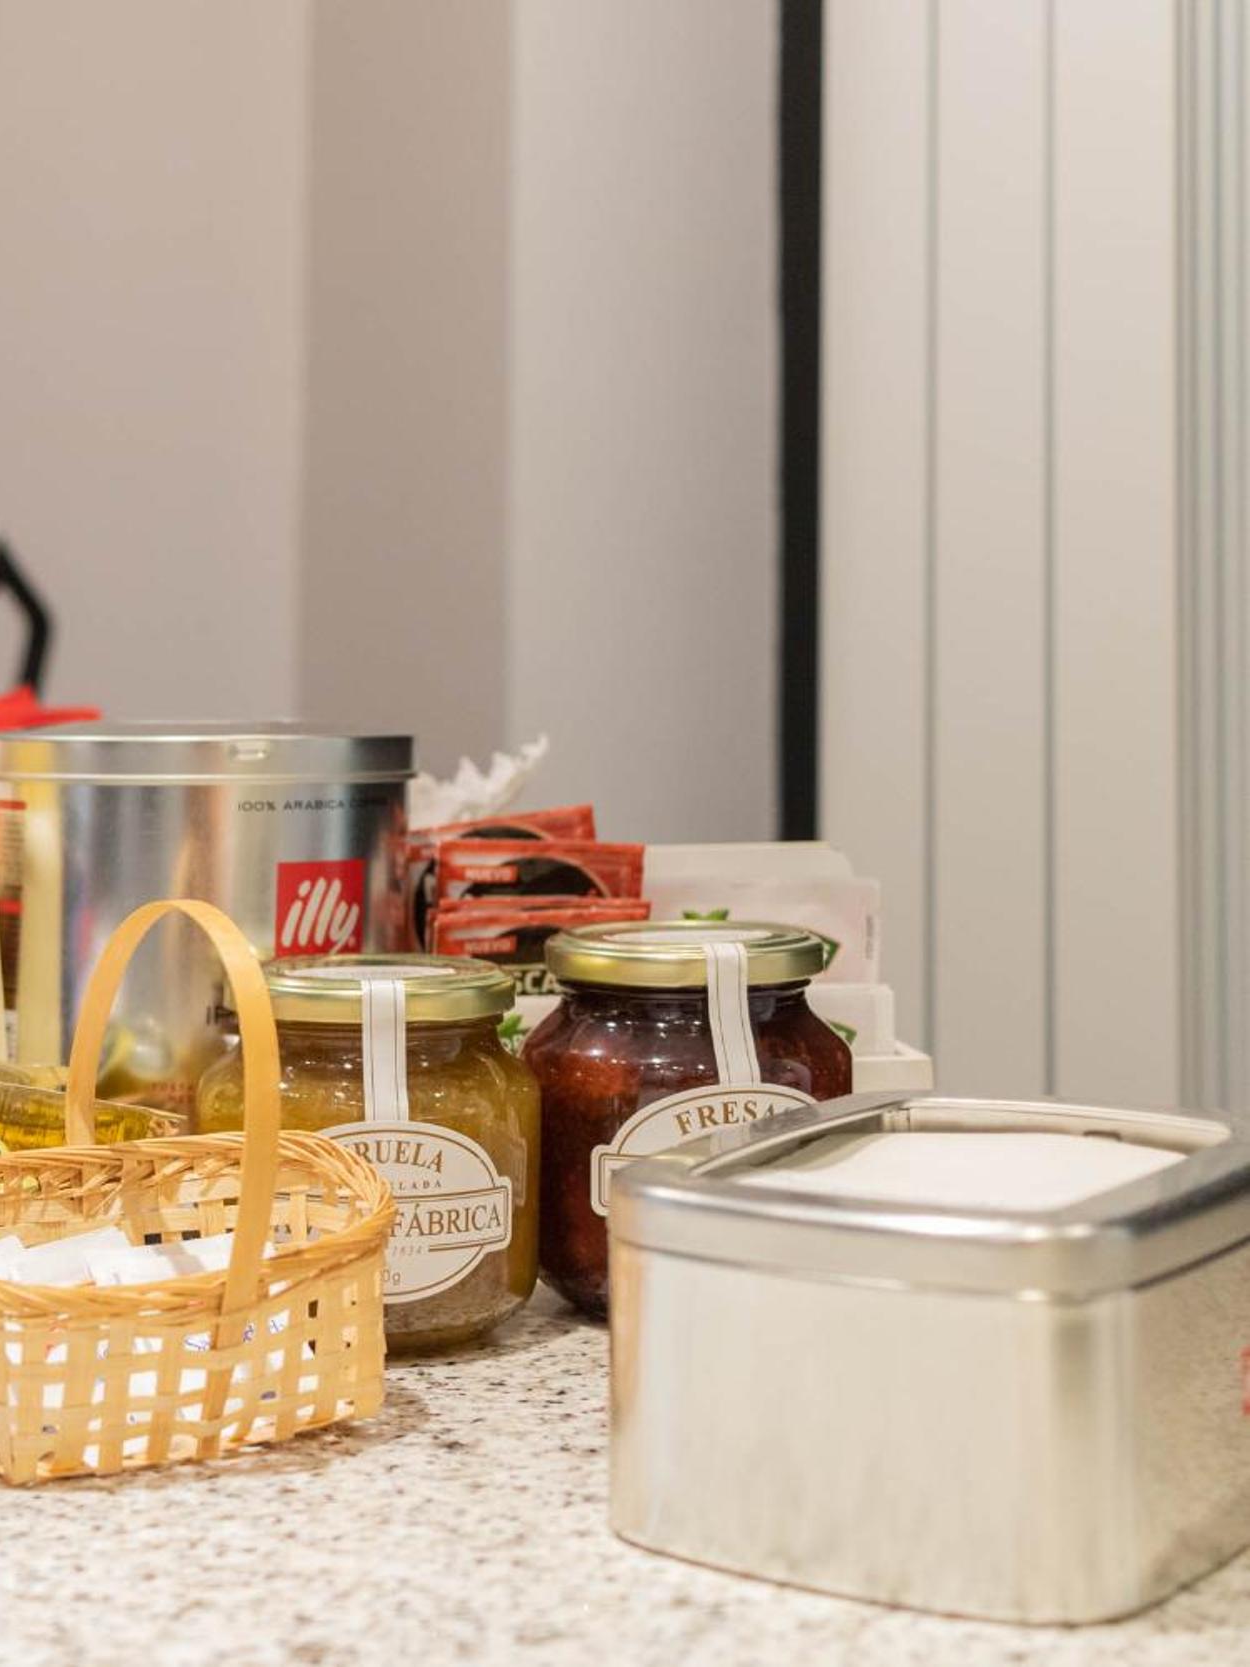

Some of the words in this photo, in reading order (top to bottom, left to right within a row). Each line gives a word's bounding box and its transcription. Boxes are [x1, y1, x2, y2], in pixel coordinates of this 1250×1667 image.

[236, 800, 277, 812] 100%
[282, 799, 346, 812] ARABICA
[280, 876, 360, 956] illy
[345, 1138, 444, 1174] RUELA
[389, 1202, 502, 1238] FÁBRICA
